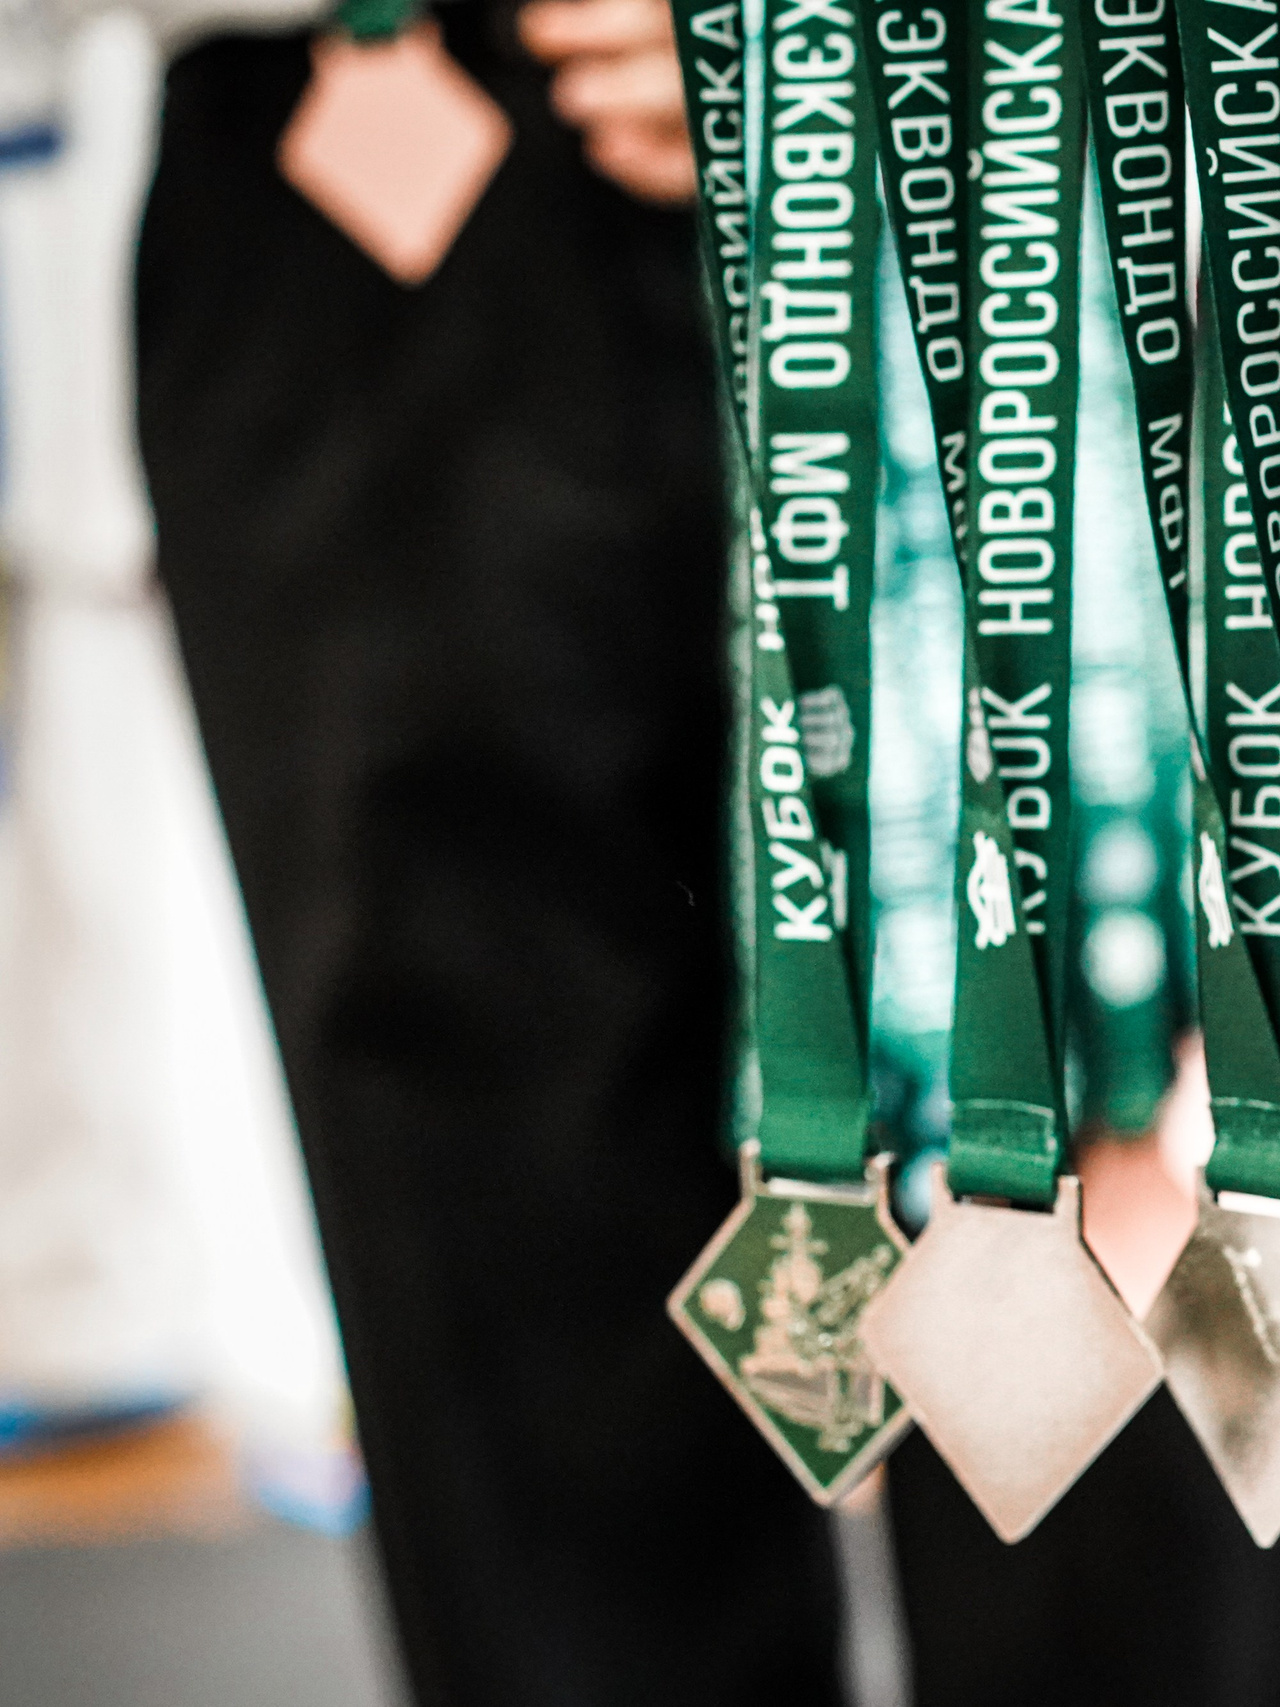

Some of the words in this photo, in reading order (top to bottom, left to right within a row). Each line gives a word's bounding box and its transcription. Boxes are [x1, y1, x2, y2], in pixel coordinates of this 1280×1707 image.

[877, 0, 964, 383] ЭКВОНДО
[769, 432, 850, 611] МФТ
[759, 697, 834, 942] КУБОК
